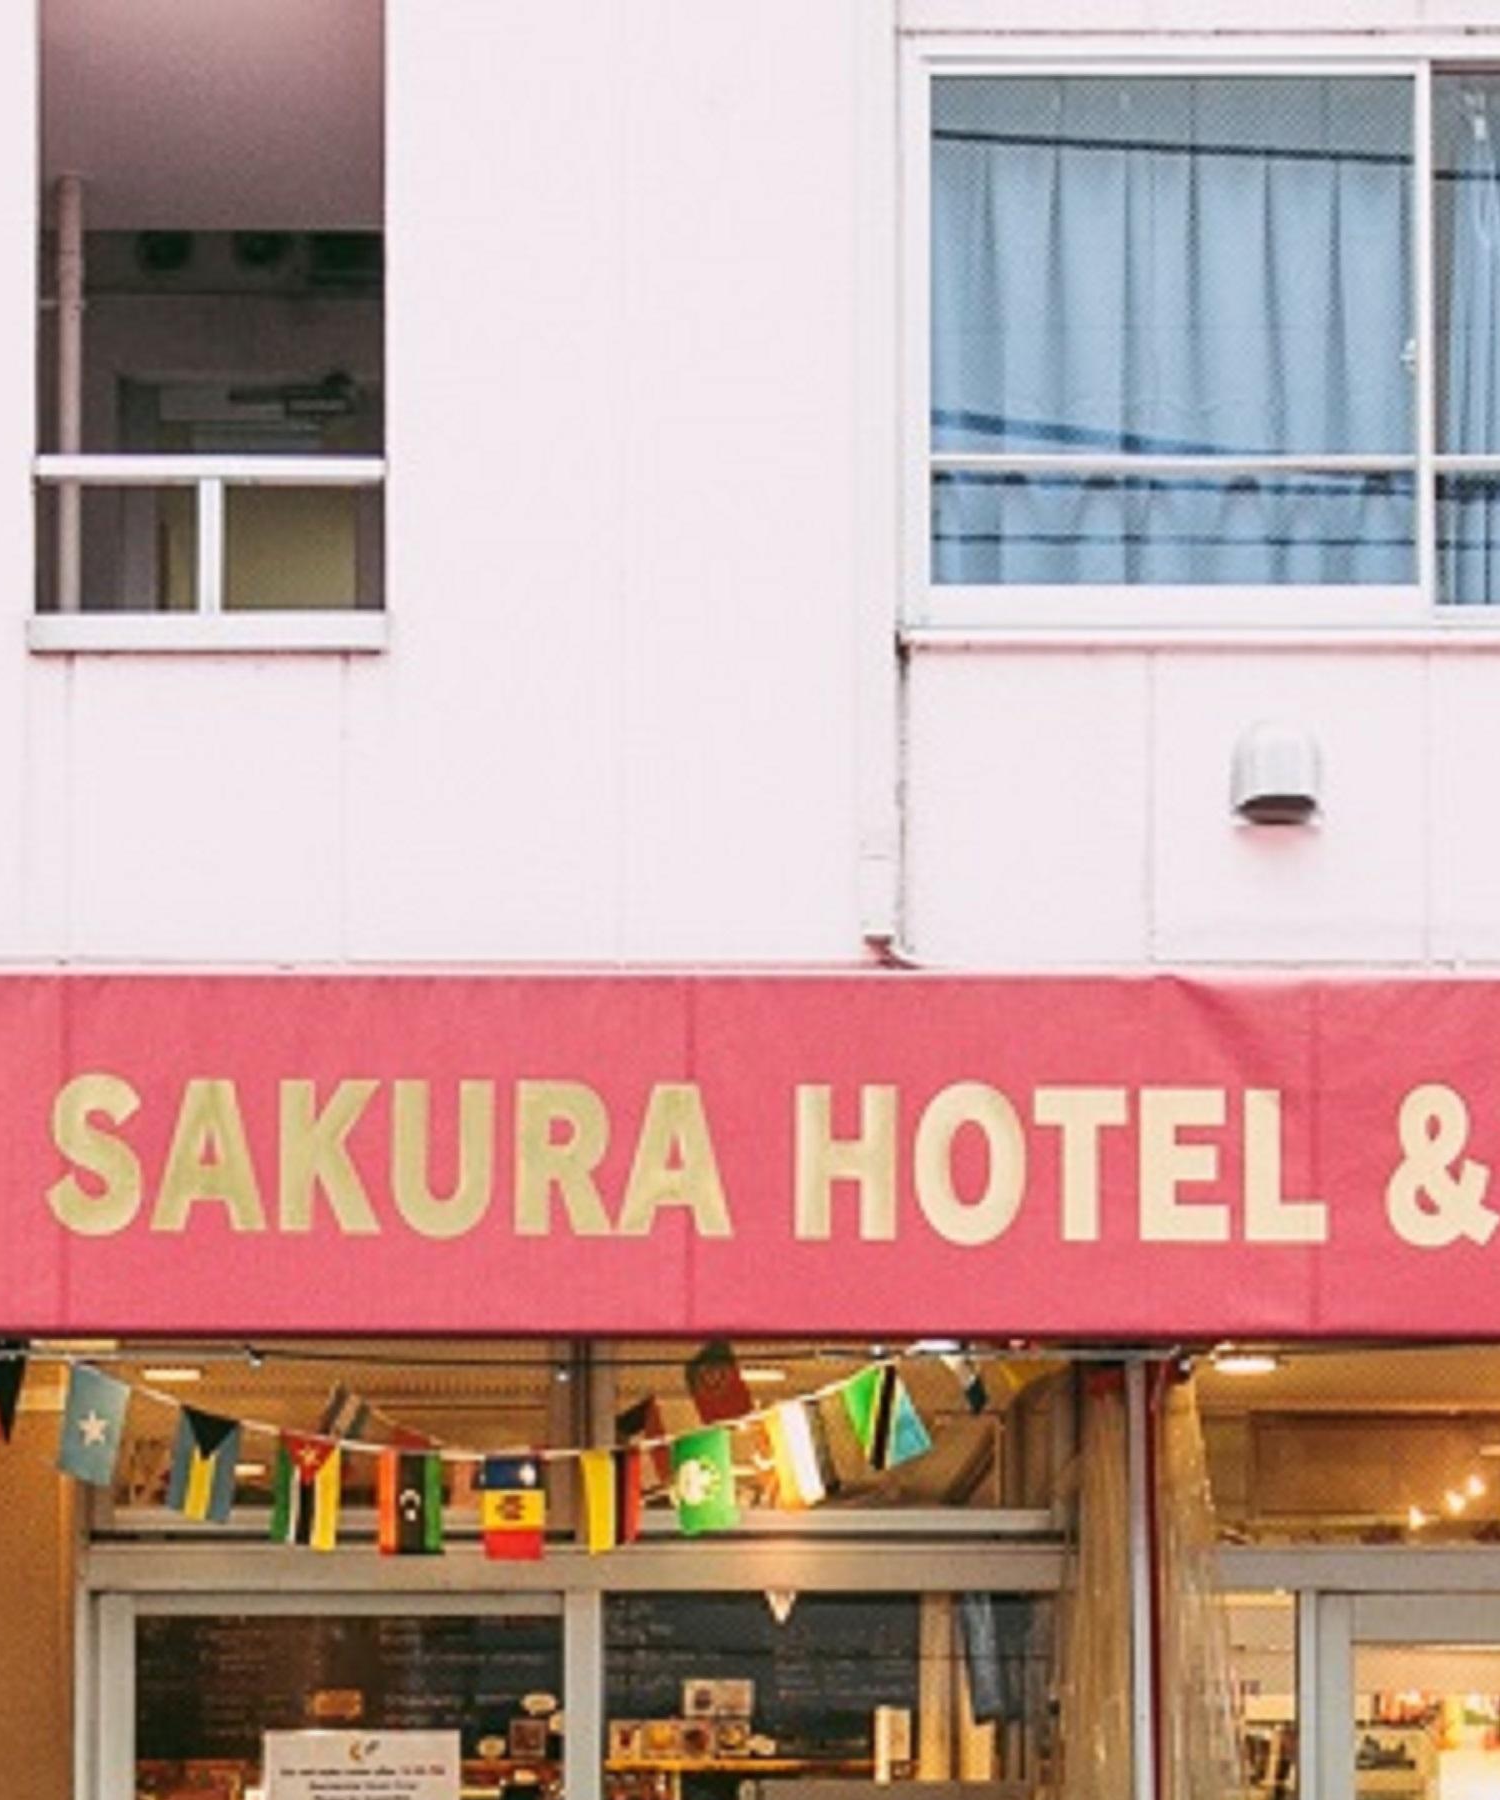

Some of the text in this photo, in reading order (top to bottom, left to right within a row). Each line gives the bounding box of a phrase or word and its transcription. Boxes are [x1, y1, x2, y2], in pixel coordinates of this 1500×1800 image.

[45, 1072, 733, 1238] SAKURA
[794, 1079, 1329, 1246] HOTEL
[1385, 1082, 1500, 1247] &
